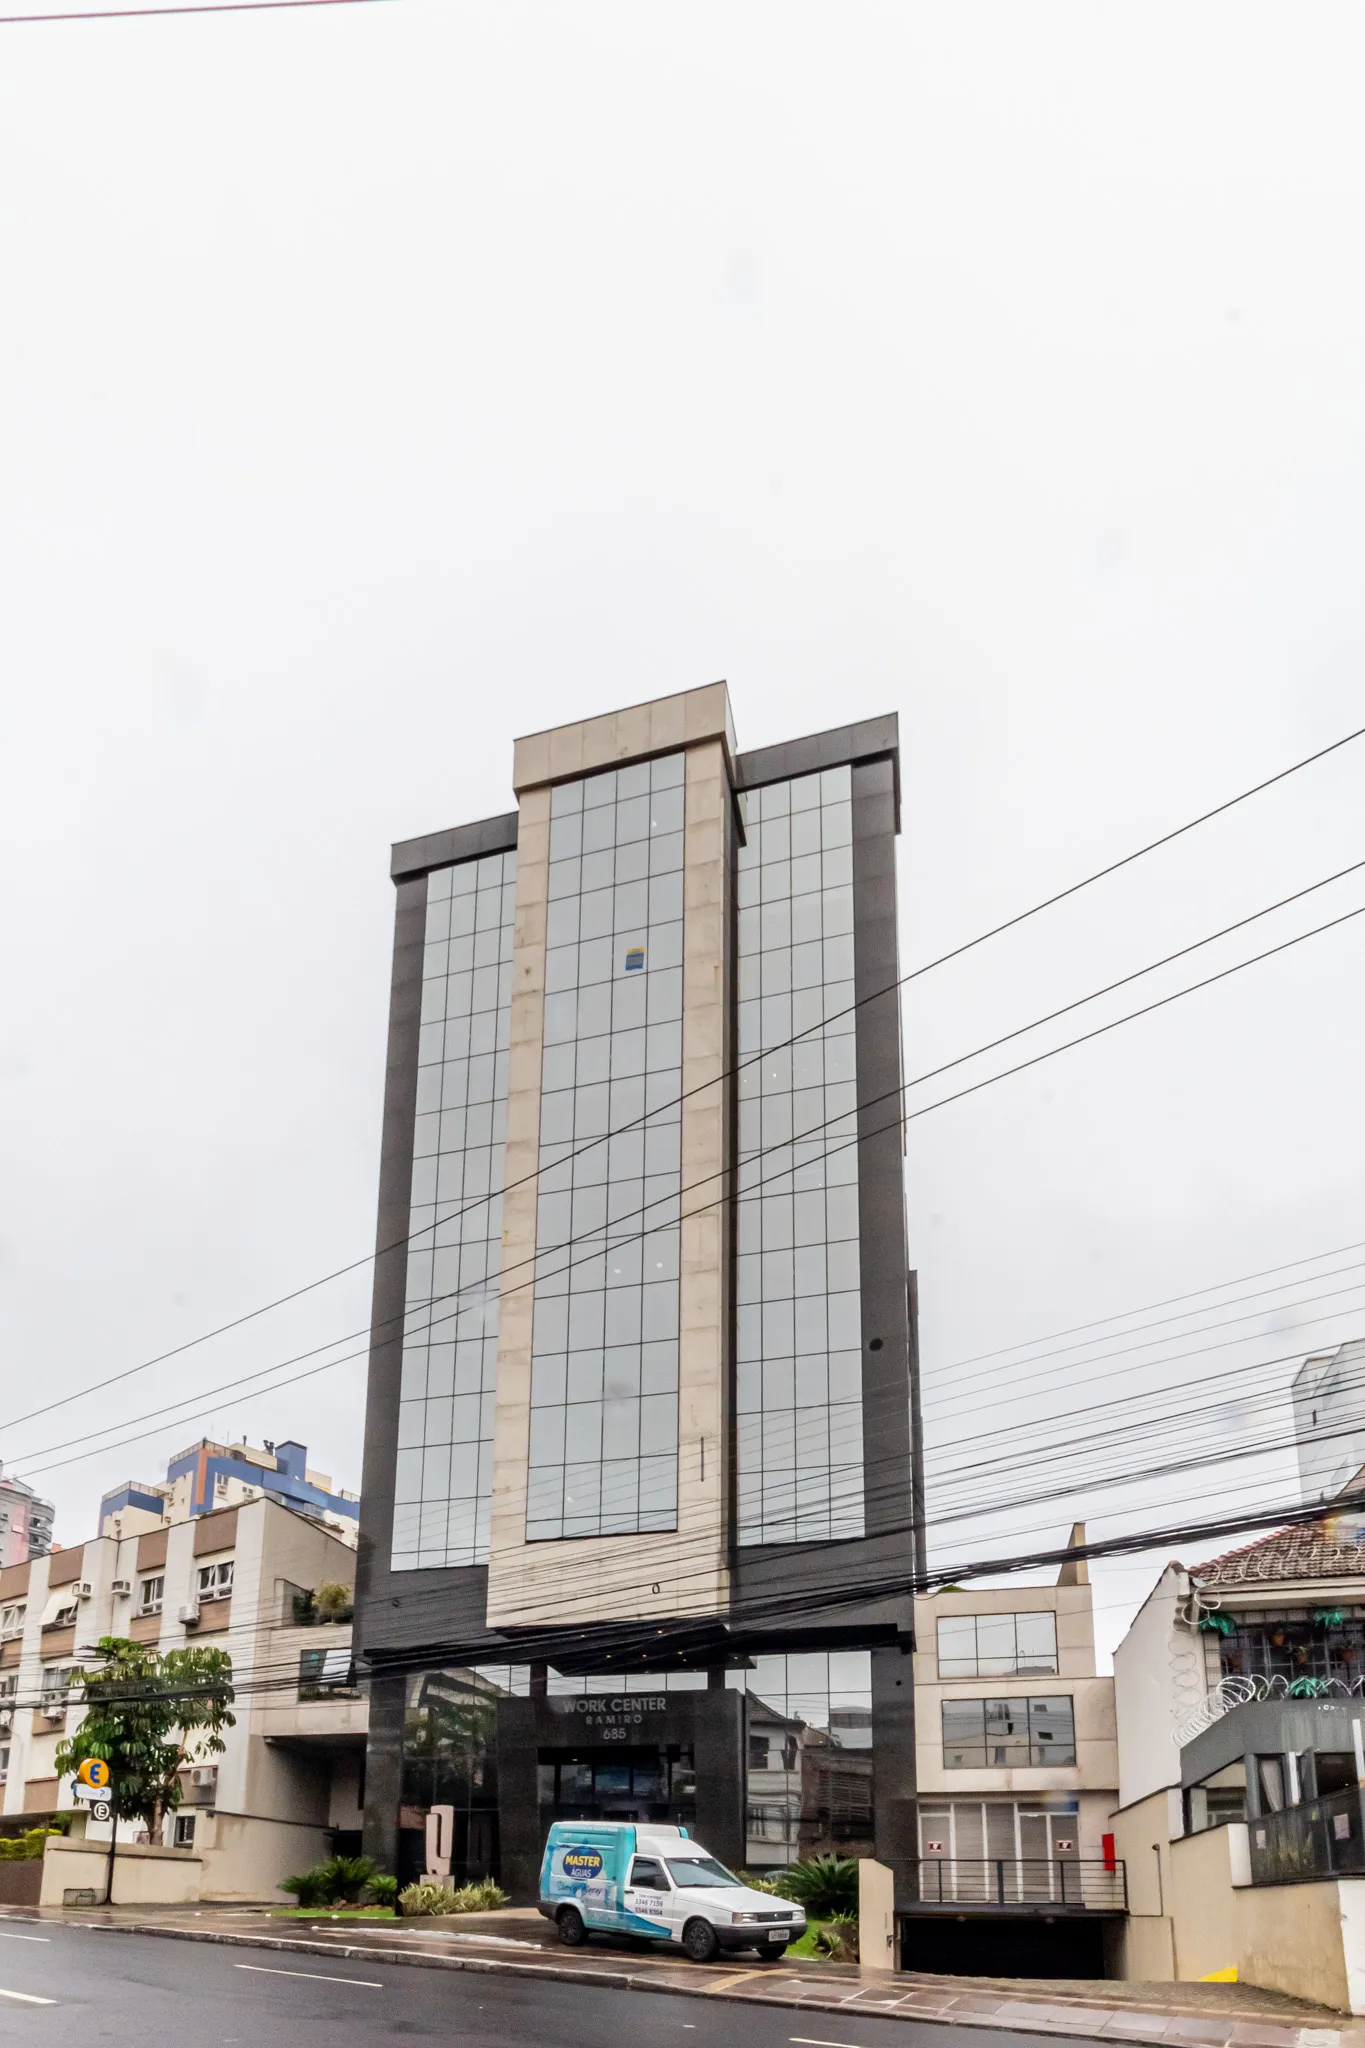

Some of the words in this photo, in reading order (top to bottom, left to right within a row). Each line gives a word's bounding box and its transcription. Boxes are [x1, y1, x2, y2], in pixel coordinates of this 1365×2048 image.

[563, 1699, 607, 1713] WORK
[611, 1697, 667, 1713] CENTER
[586, 1714, 643, 1725] RAMIRO
[603, 1728, 626, 1740] 685
[90, 1763, 101, 1783] E
[98, 1805, 106, 1817] E
[565, 1855, 600, 1867] MASTER
[571, 1866, 592, 1878] ÁGUAS
